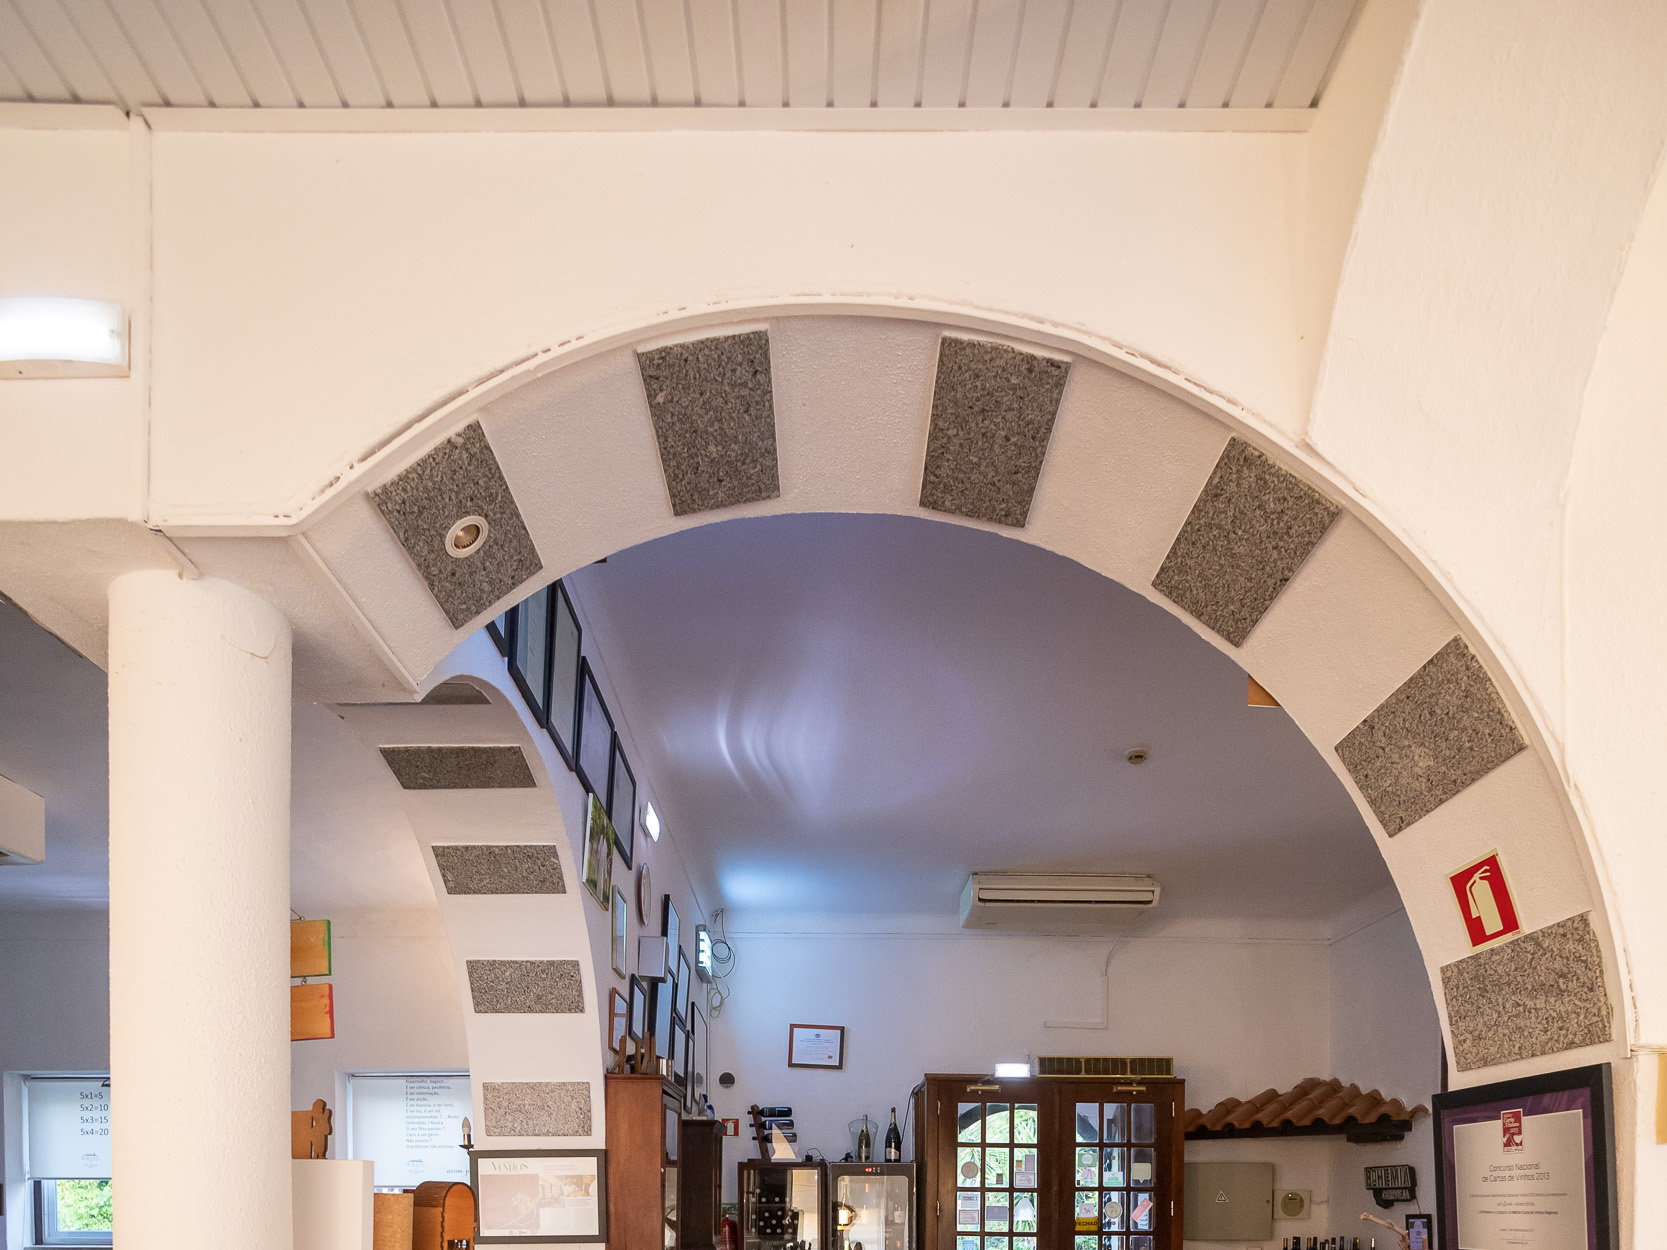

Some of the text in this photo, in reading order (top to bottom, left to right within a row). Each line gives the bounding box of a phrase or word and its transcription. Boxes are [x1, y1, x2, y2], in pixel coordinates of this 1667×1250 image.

[1489, 1162, 1540, 1172] Concurso Nacional
[1365, 1166, 1411, 1188] BOHEMIA
[1489, 1174, 1506, 1182] Cartas
[1508, 1174, 1514, 1182] de
[1516, 1173, 1535, 1181] Vinhos
[1536, 1172, 1550, 1180] 2013
